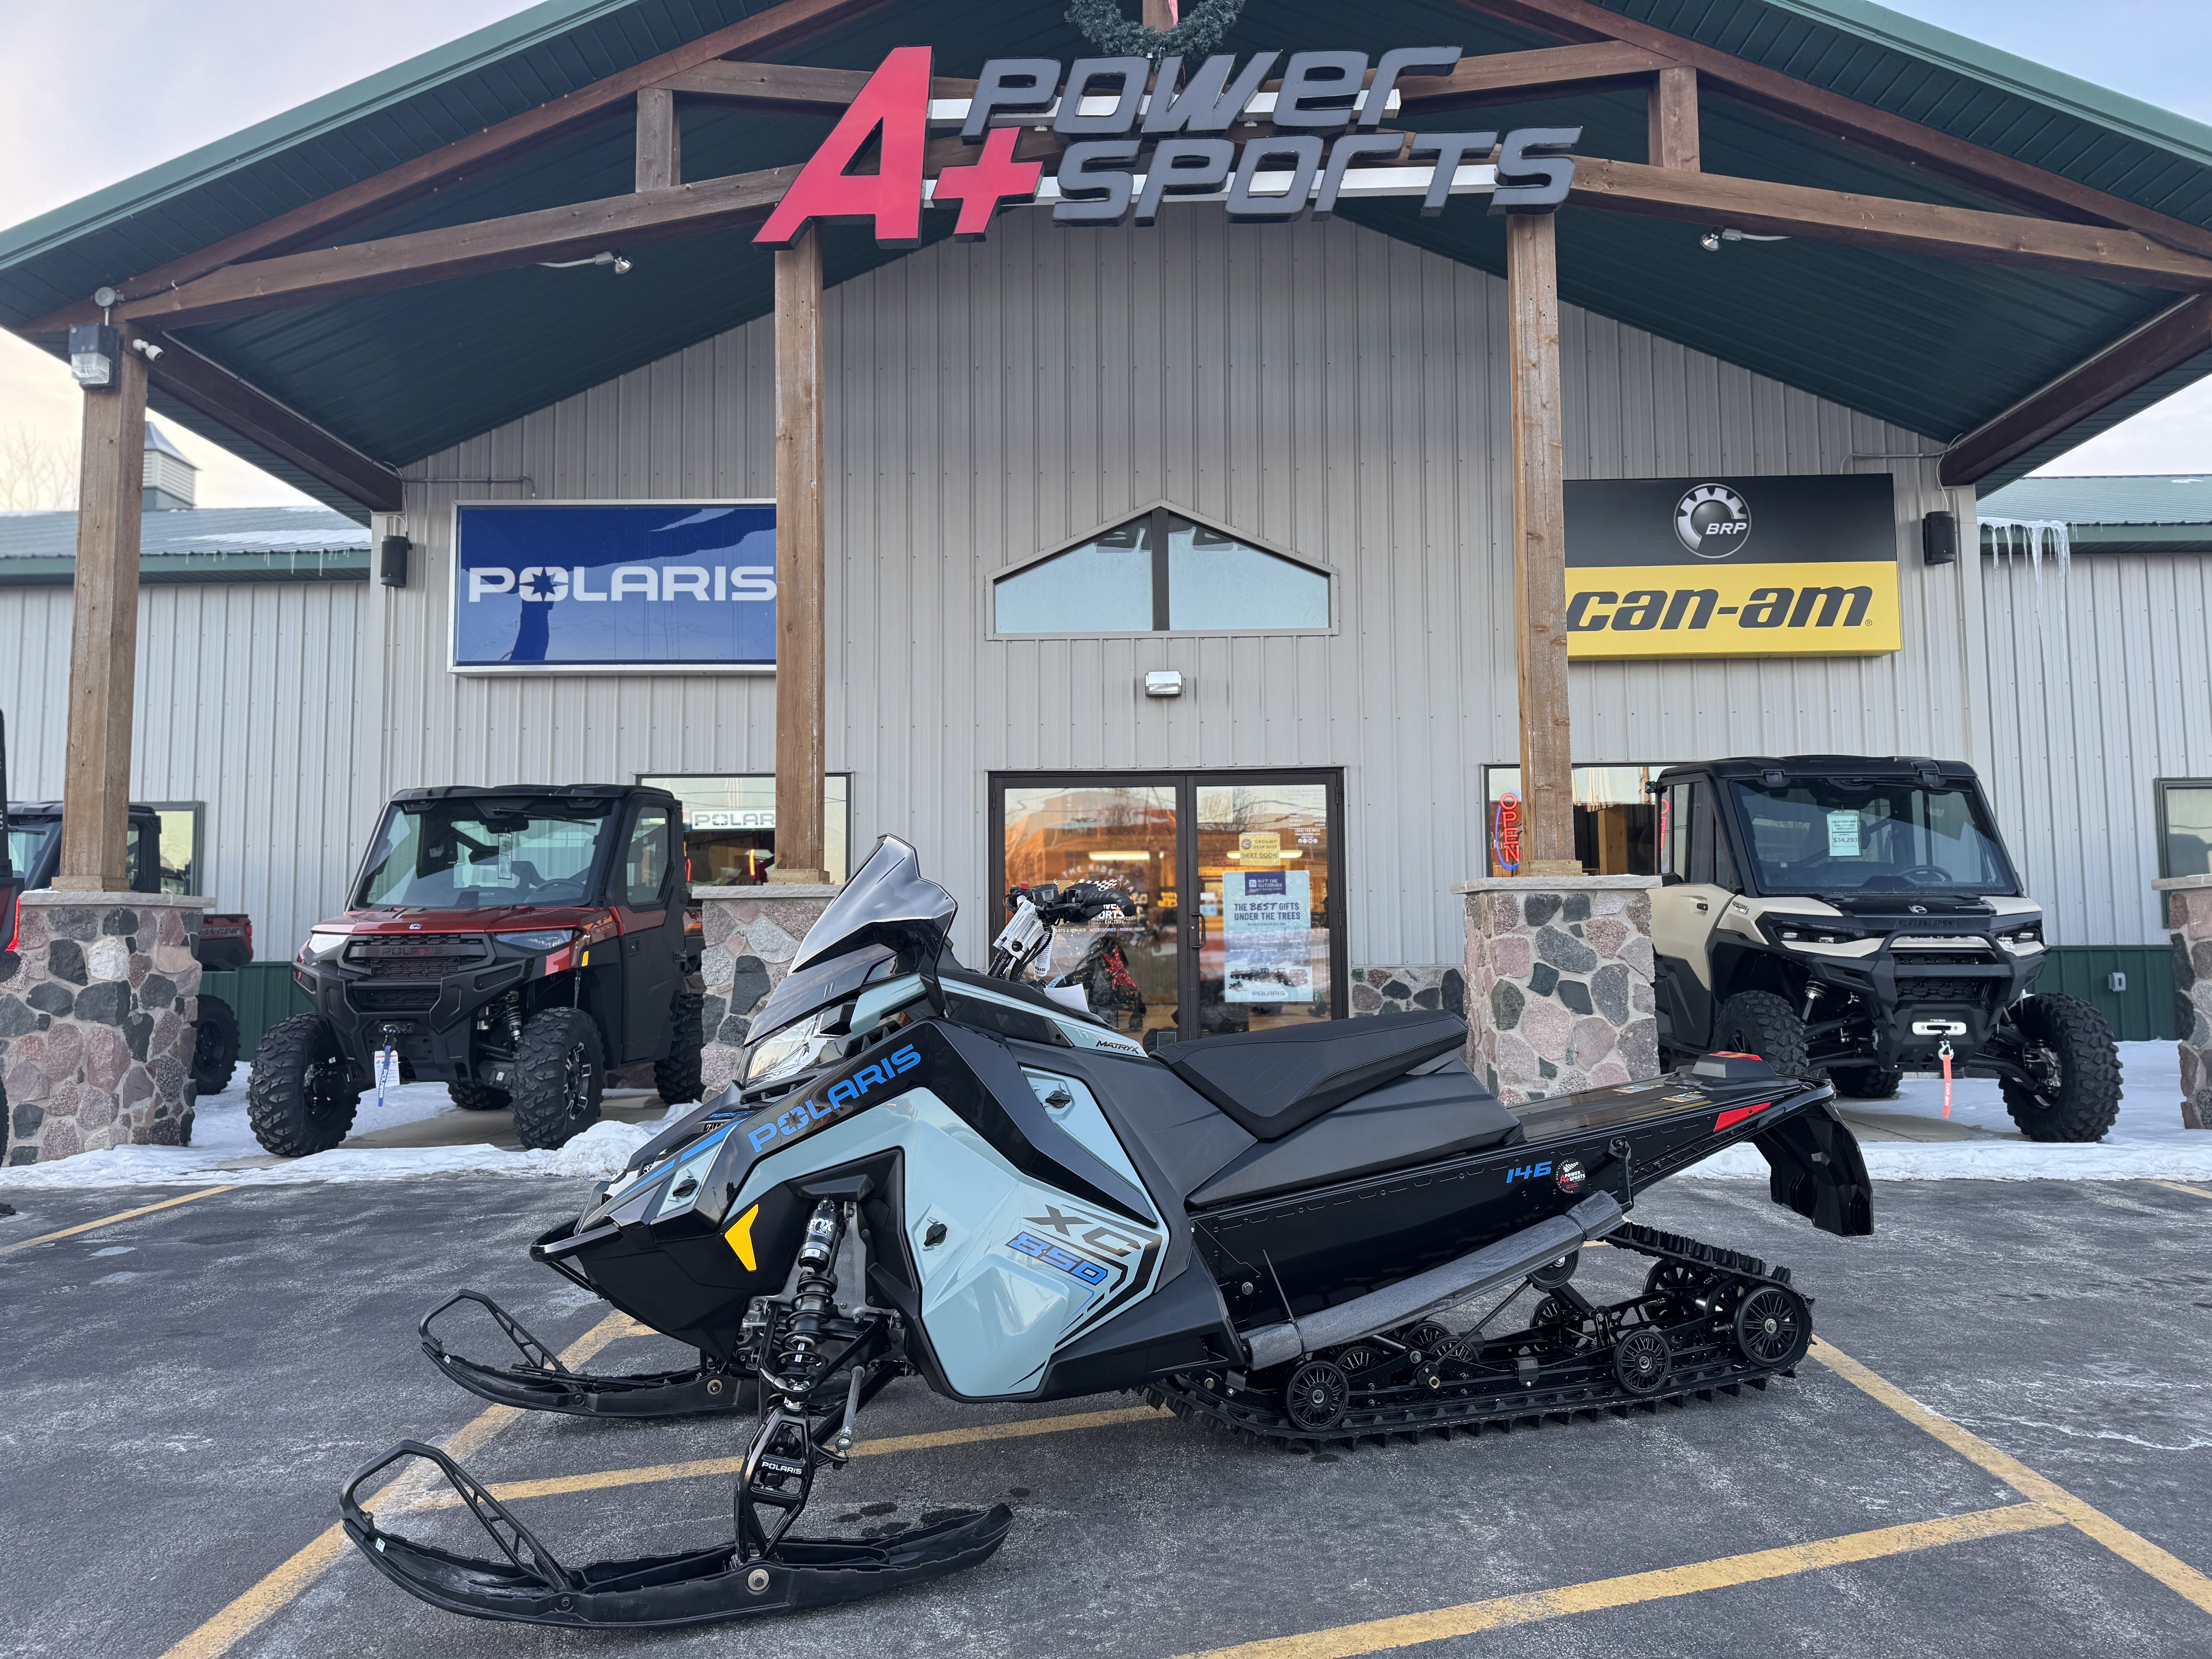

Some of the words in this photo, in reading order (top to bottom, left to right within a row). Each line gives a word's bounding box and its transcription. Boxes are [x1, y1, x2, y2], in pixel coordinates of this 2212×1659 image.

[1705, 522, 1748, 536] BRP
[468, 565, 777, 603] POLARIS
[1566, 586, 1874, 632] can-am
[694, 812, 776, 826] POLAR
[1500, 792, 1520, 863] OPEN
[1062, 866, 1082, 878] THE
[1089, 864, 1114, 875] RIDE
[382, 947, 445, 955] POLARIS
[1096, 1040, 1139, 1054] MATRYX
[379, 1069, 388, 1098] POLARIS
[747, 1044, 921, 1153] POLARIS
[1506, 1161, 1552, 1183] 146
[809, 1218, 834, 1236] FOX
[1022, 1204, 1142, 1257] XC
[1005, 1231, 1109, 1286] 850
[762, 1462, 802, 1474] POLARIS
